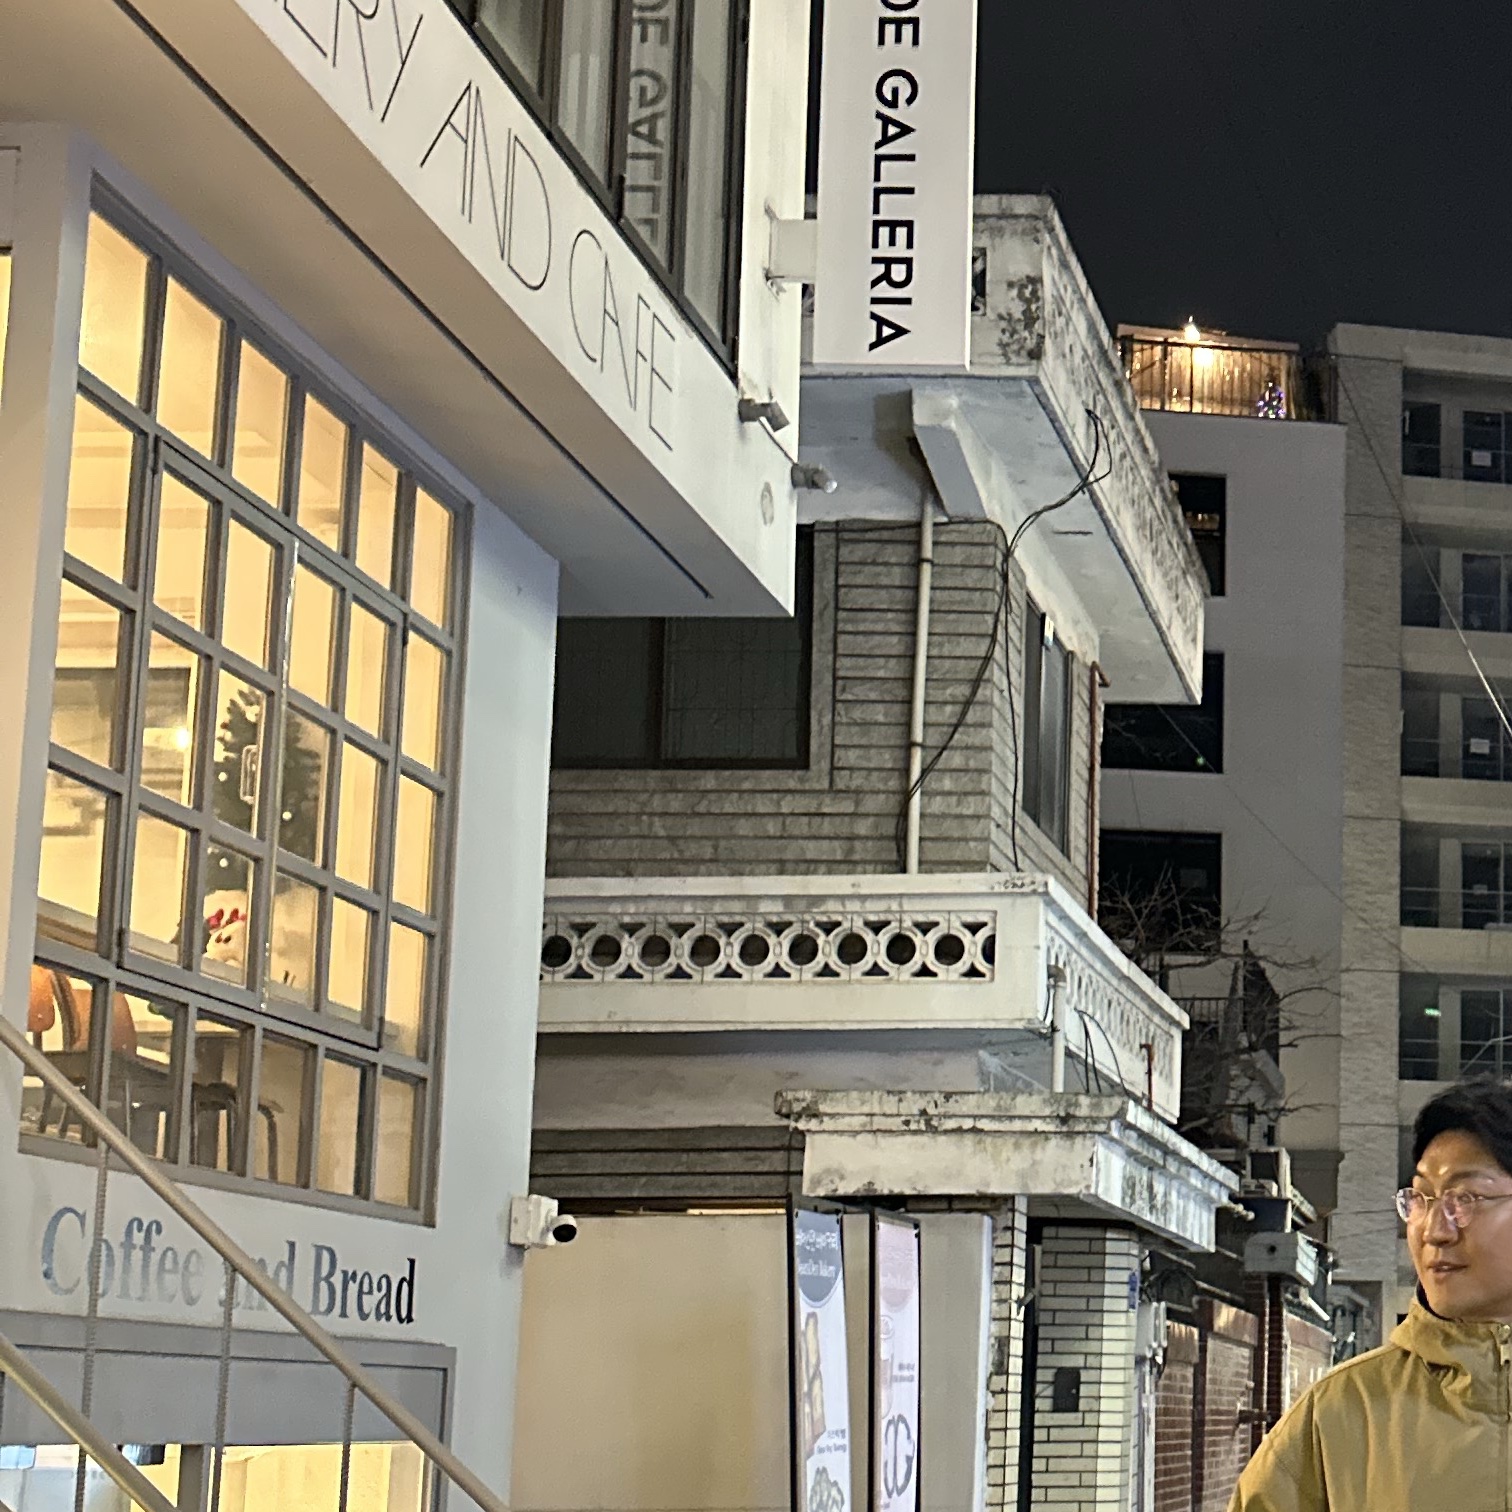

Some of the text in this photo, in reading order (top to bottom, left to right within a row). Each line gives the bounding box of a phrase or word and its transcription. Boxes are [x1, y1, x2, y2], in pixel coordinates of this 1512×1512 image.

[420, 80, 552, 291] AND
[568, 229, 677, 452] CAFE
[868, 68, 920, 353] GALLERIA
[41, 1205, 201, 1308] Coffee
[309, 1243, 417, 1326] Bread
